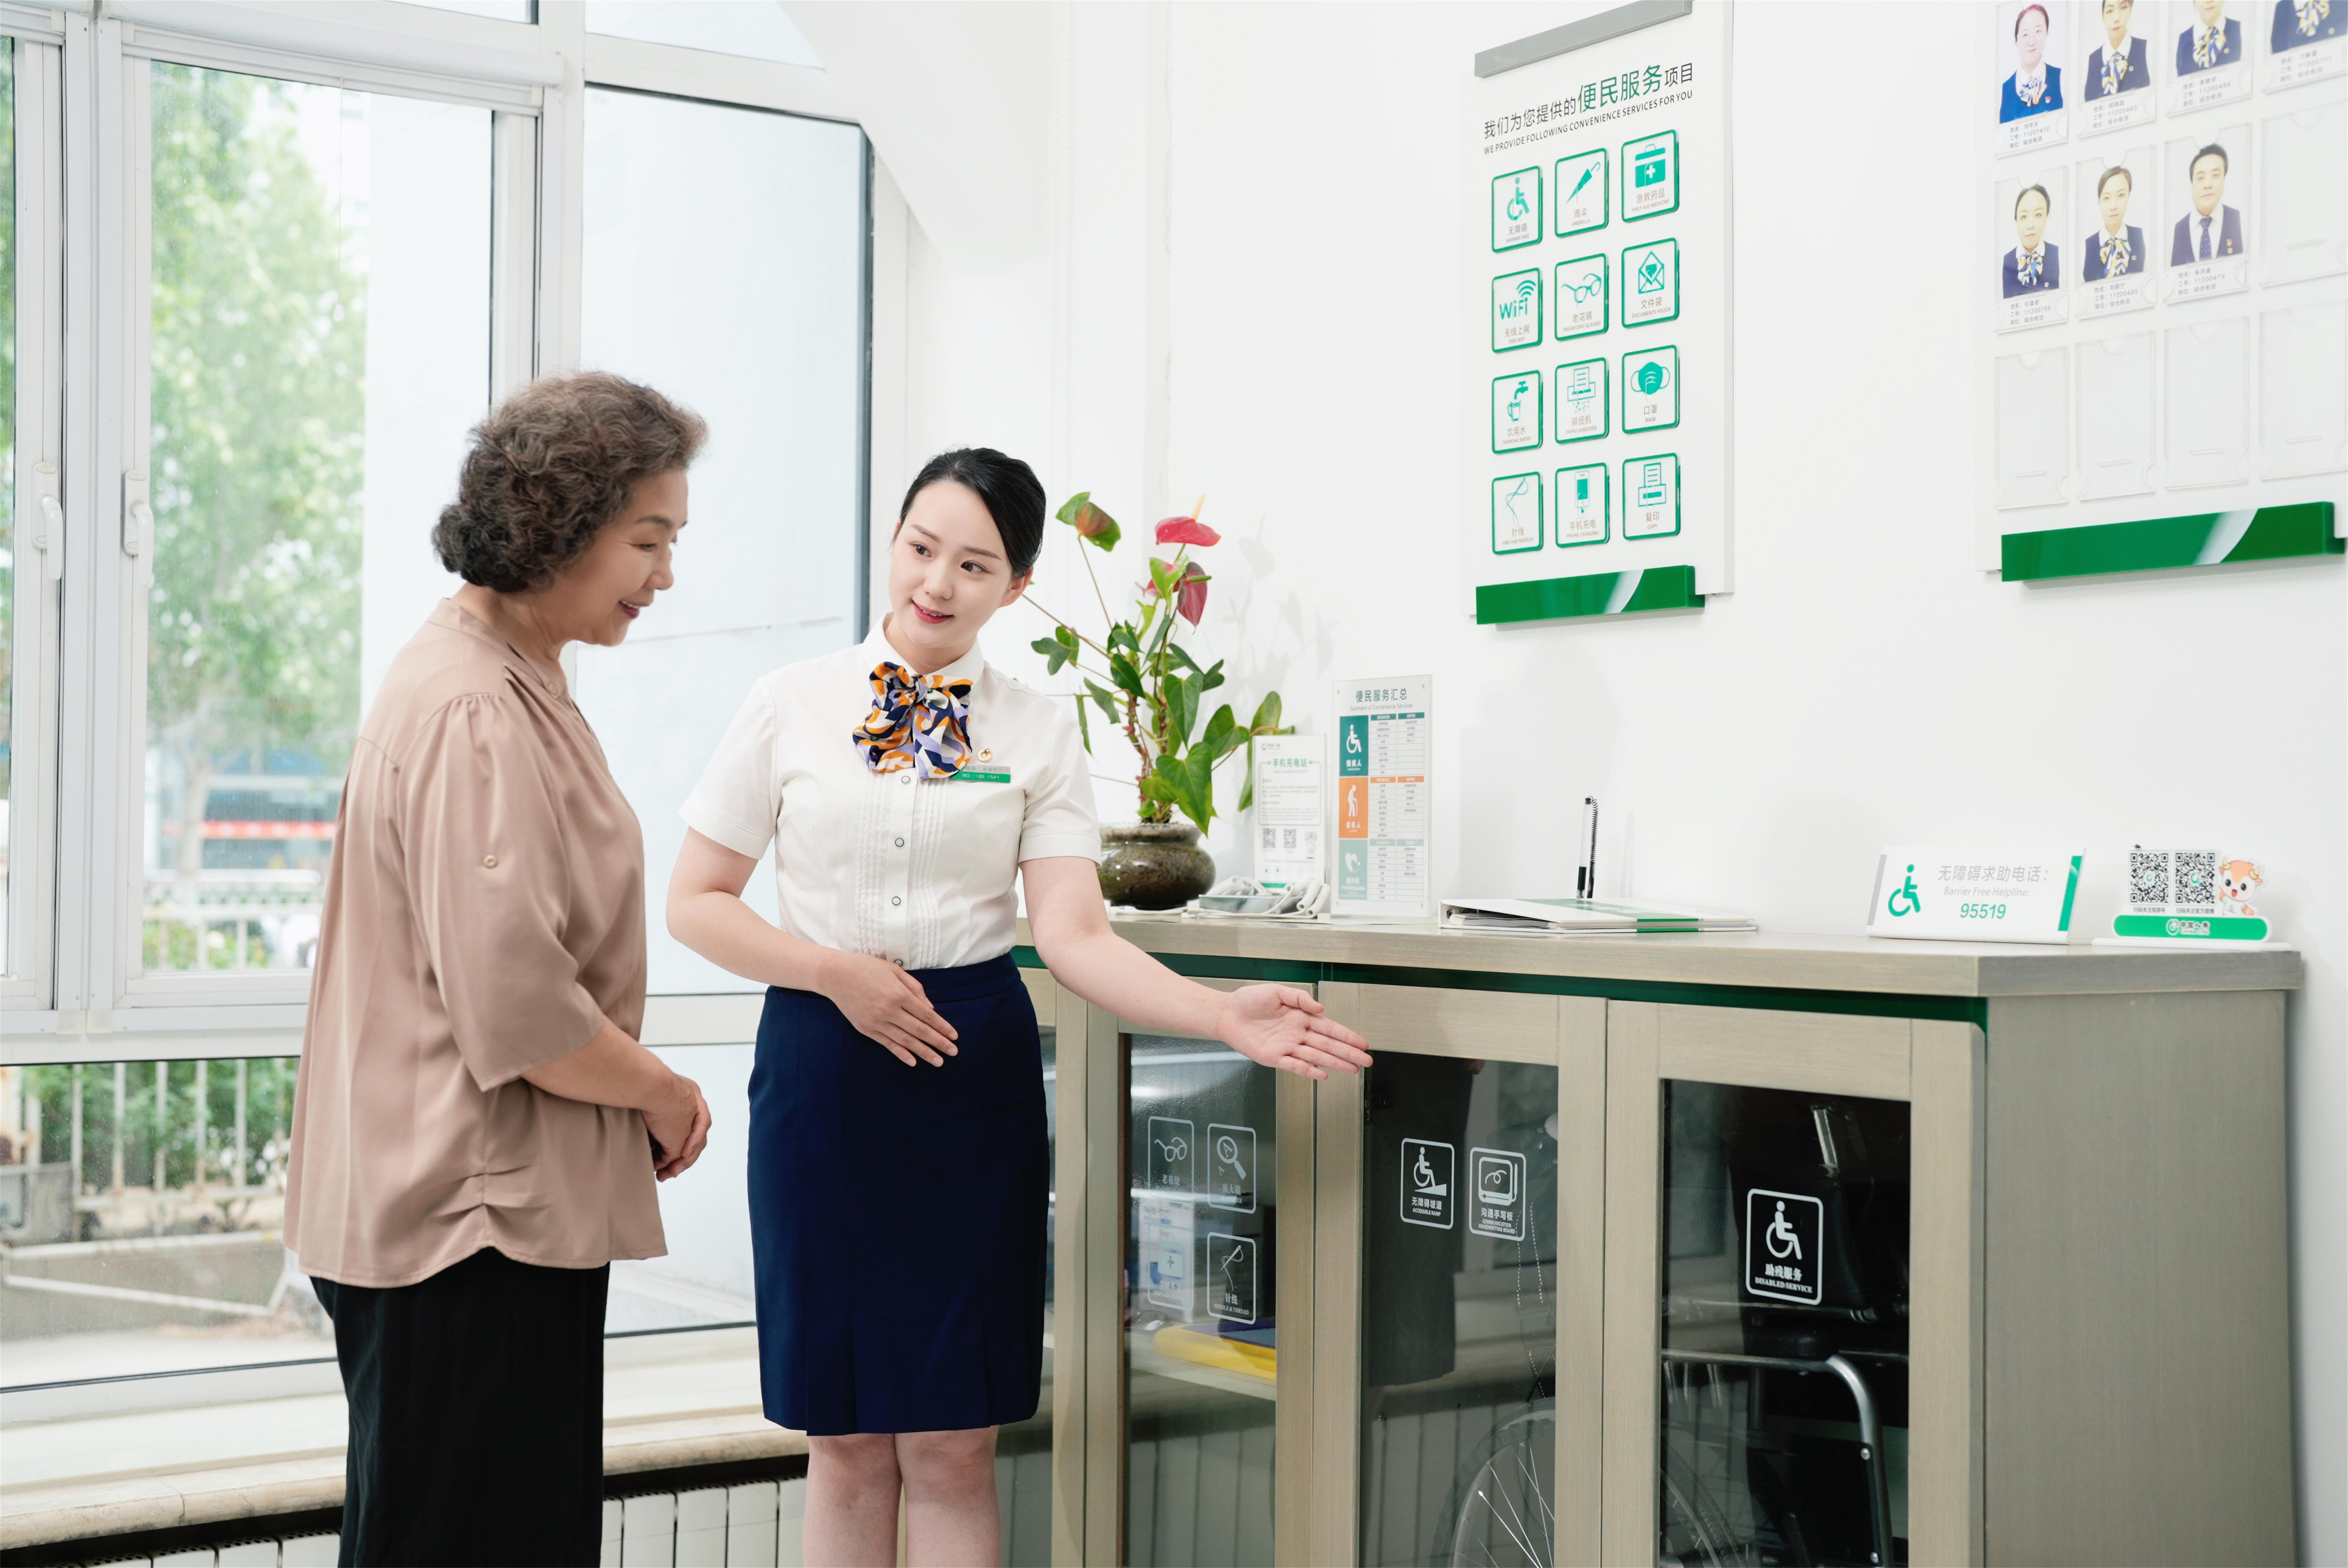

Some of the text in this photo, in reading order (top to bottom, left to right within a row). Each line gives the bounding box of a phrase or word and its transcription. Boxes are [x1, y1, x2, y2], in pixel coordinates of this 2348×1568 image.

[1485, 63, 1692, 139] 我们为您提供的便民服务项目
[1484, 90, 1692, 155] WE PROVIDE FOLLOWING CONVENIENCE SERVICES FOR YOU
[1637, 188, 1665, 203] 急救药品
[1574, 208, 1587, 218] 雨伞
[1508, 223, 1527, 235] 无障碍
[1641, 297, 1662, 309] 文件袋
[1573, 311, 1592, 323] 老花镜
[1632, 310, 1656, 318] DOCUMENTS
[1505, 325, 1530, 337] 无线上网
[1585, 321, 1601, 329] GLASSES
[1644, 405, 1657, 415] 口罩
[1572, 415, 1591, 426] 碎纸机
[1507, 426, 1526, 437] 饮用水
[1646, 512, 1660, 522] 复印
[1570, 519, 1596, 531] 手机充电
[1356, 688, 1407, 703] 便民服务汇总
[1944, 886, 2030, 898] Barrier Free Helpline:
[1960, 903, 2006, 919] 95519
[1411, 1196, 1442, 1210] 无障碍坡道
[1412, 1207, 1431, 1215] ACCESSIBLE
[1481, 1207, 1513, 1221] 沟通手写板
[1482, 1218, 1511, 1228] COMMUNICATION
[1765, 1263, 1803, 1282] 助残服务
[1755, 1276, 1813, 1294] DISABLED SERVICE
[1225, 1293, 1238, 1305] 针线
[1233, 1307, 1249, 1315] THREAD
